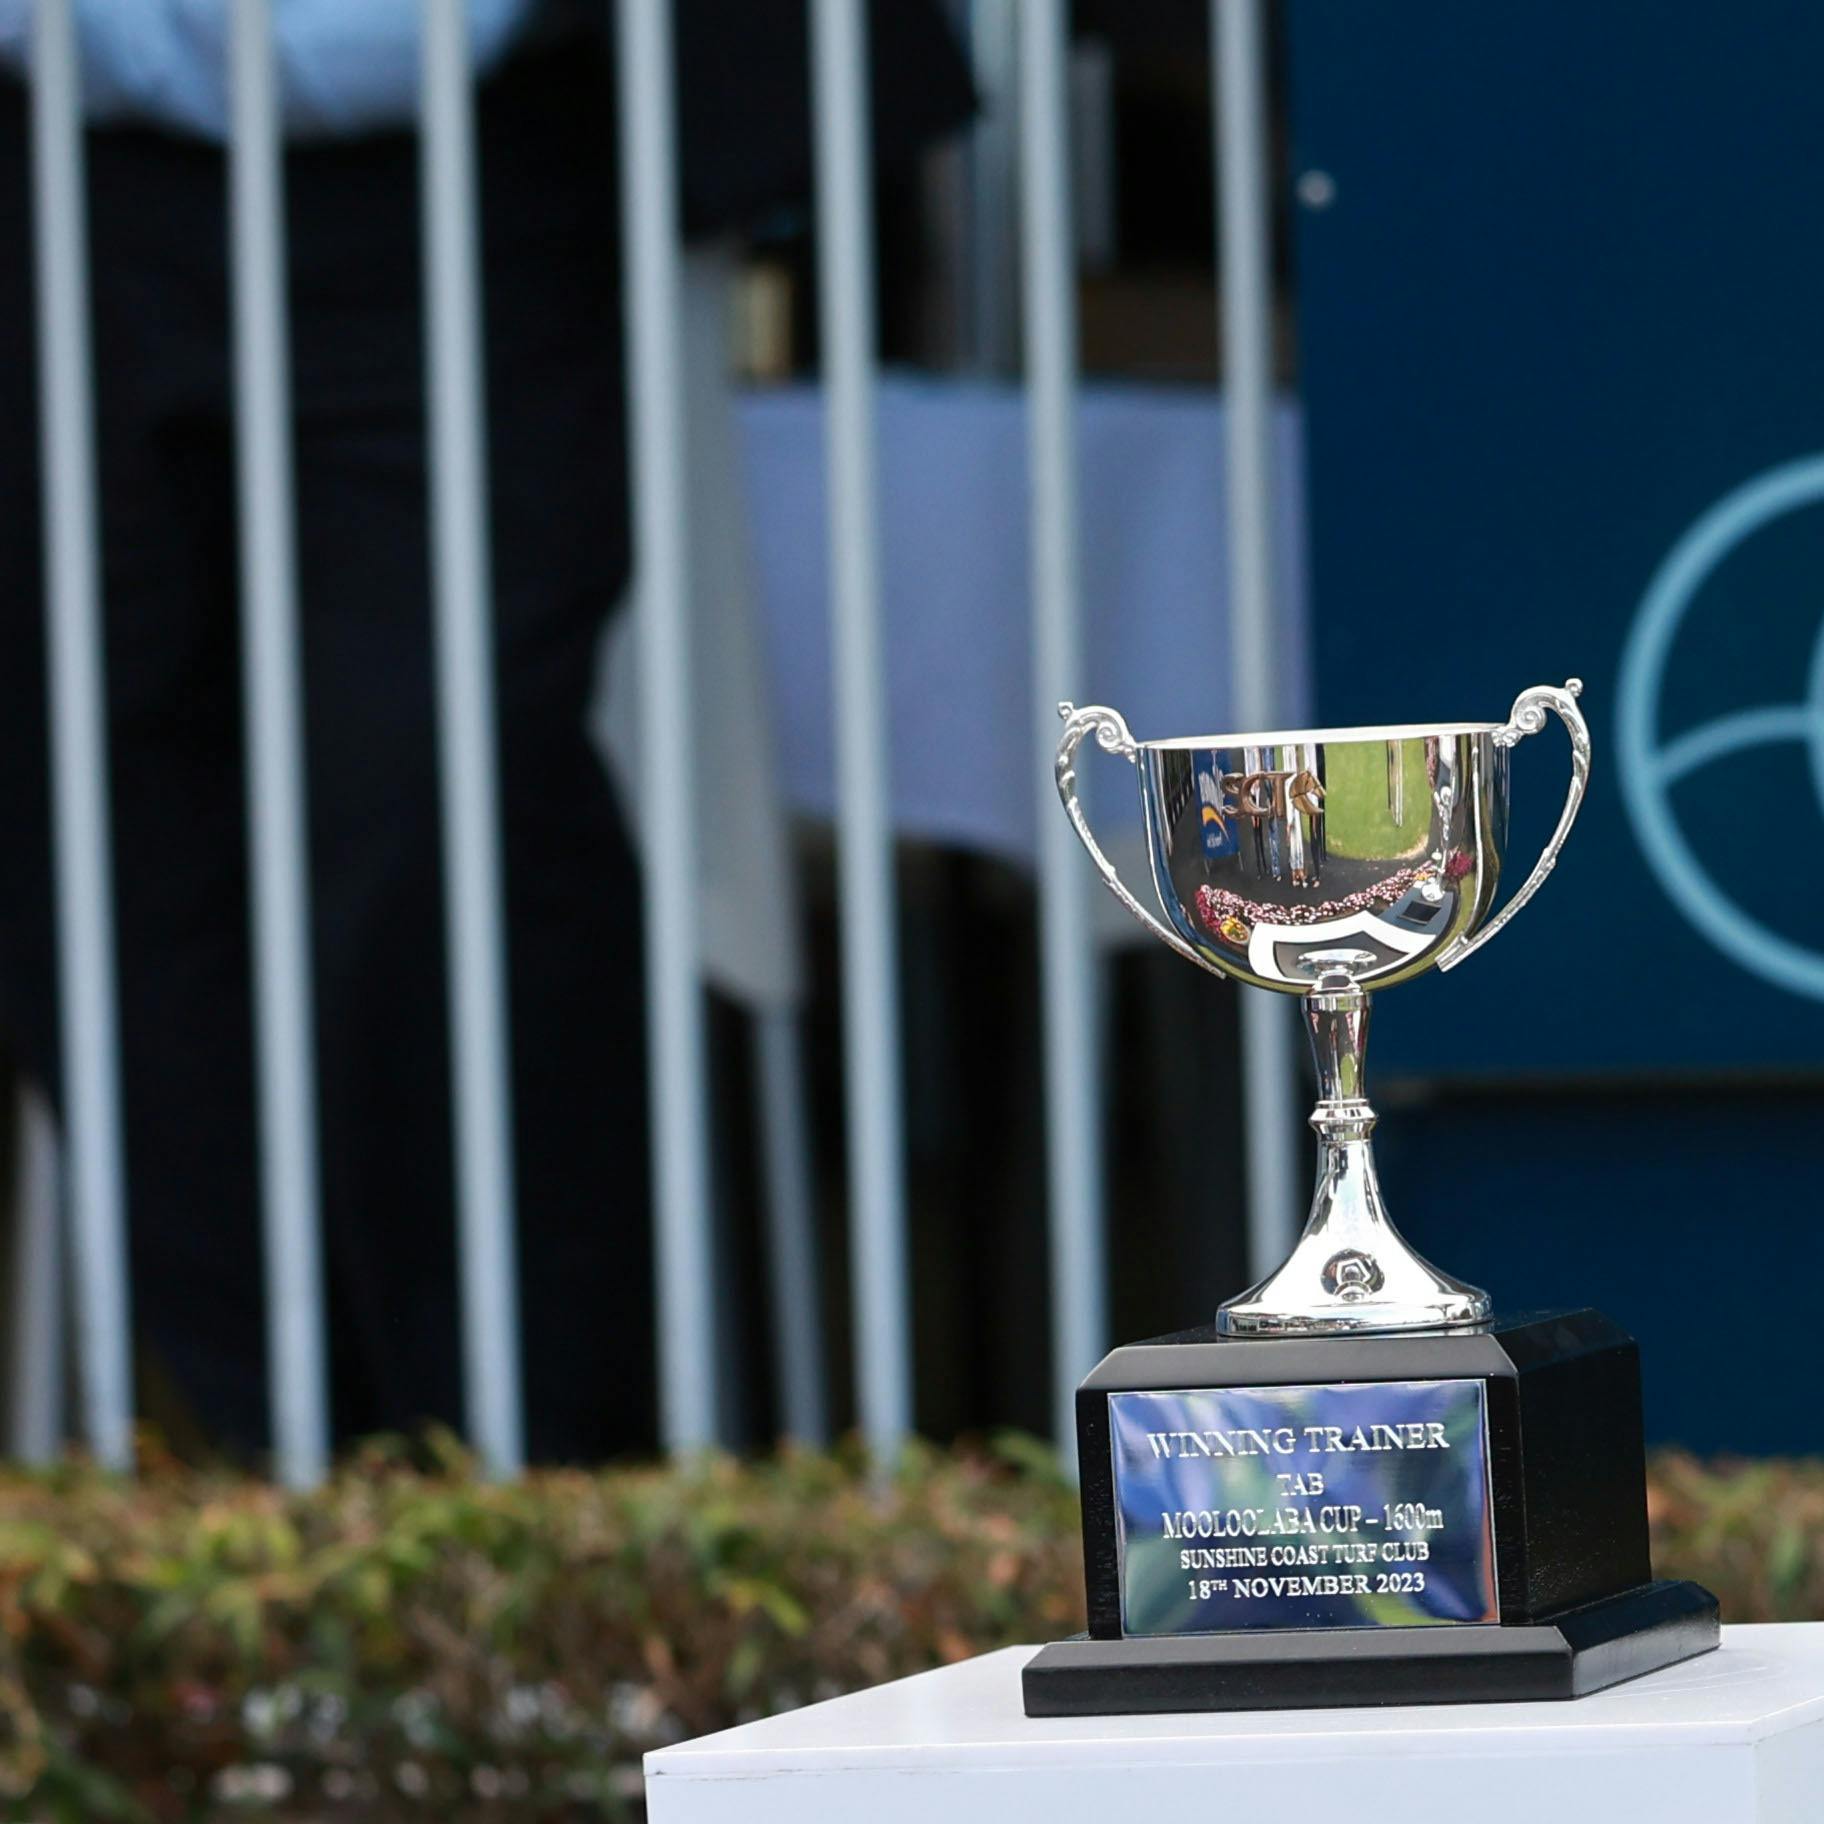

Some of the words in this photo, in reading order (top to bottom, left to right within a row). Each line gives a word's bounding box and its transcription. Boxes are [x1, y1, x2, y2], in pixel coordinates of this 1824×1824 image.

[1147, 1428, 1297, 1459] WINNING
[1304, 1422, 1450, 1452] TRAINER
[1277, 1472, 1325, 1496] TAB
[1162, 1507, 1317, 1539] MOOLOOLABA
[1319, 1505, 1361, 1534] CUP
[1384, 1502, 1444, 1532] 1600m
[1180, 1547, 1268, 1570] SUNSHINE
[1270, 1545, 1331, 1567] COAST
[1333, 1543, 1378, 1565] TURF
[1381, 1541, 1430, 1562] CLUB
[1232, 1574, 1371, 1599] NOVEMBER
[1377, 1572, 1425, 1593] 2023
